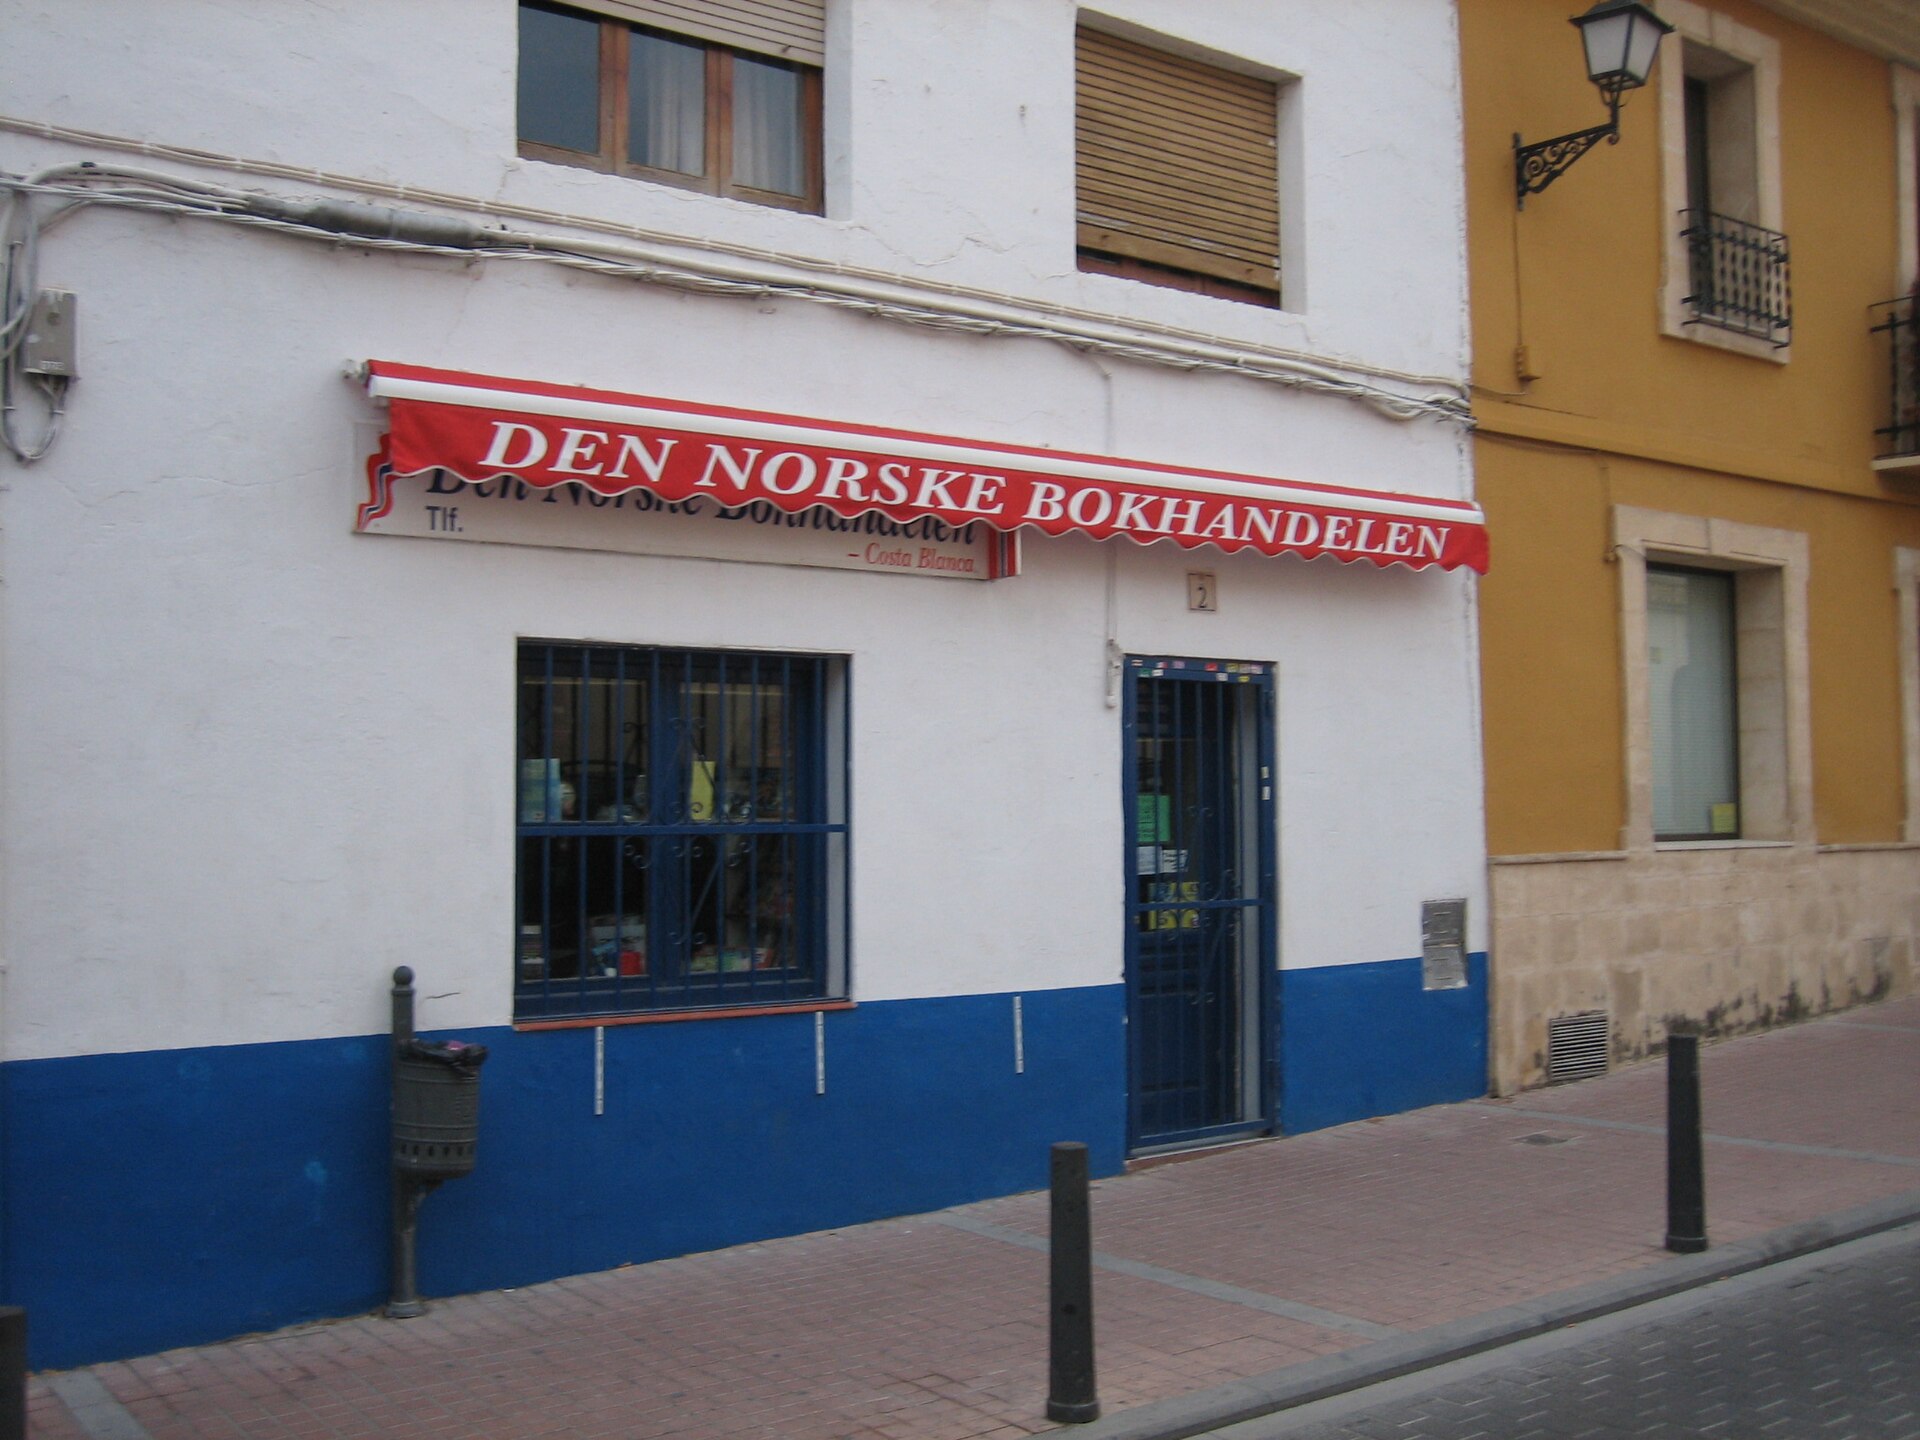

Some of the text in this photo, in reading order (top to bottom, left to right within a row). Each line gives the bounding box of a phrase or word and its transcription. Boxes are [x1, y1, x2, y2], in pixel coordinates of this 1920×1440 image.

[477, 420, 1452, 561] DEN NORSKE BOKHANDELEN
[542, 479, 703, 515] ose
[425, 504, 464, 532] Tlf.
[865, 542, 912, 568] Costa
[917, 546, 975, 573] Blanca
[1198, 584, 1208, 608] 2
